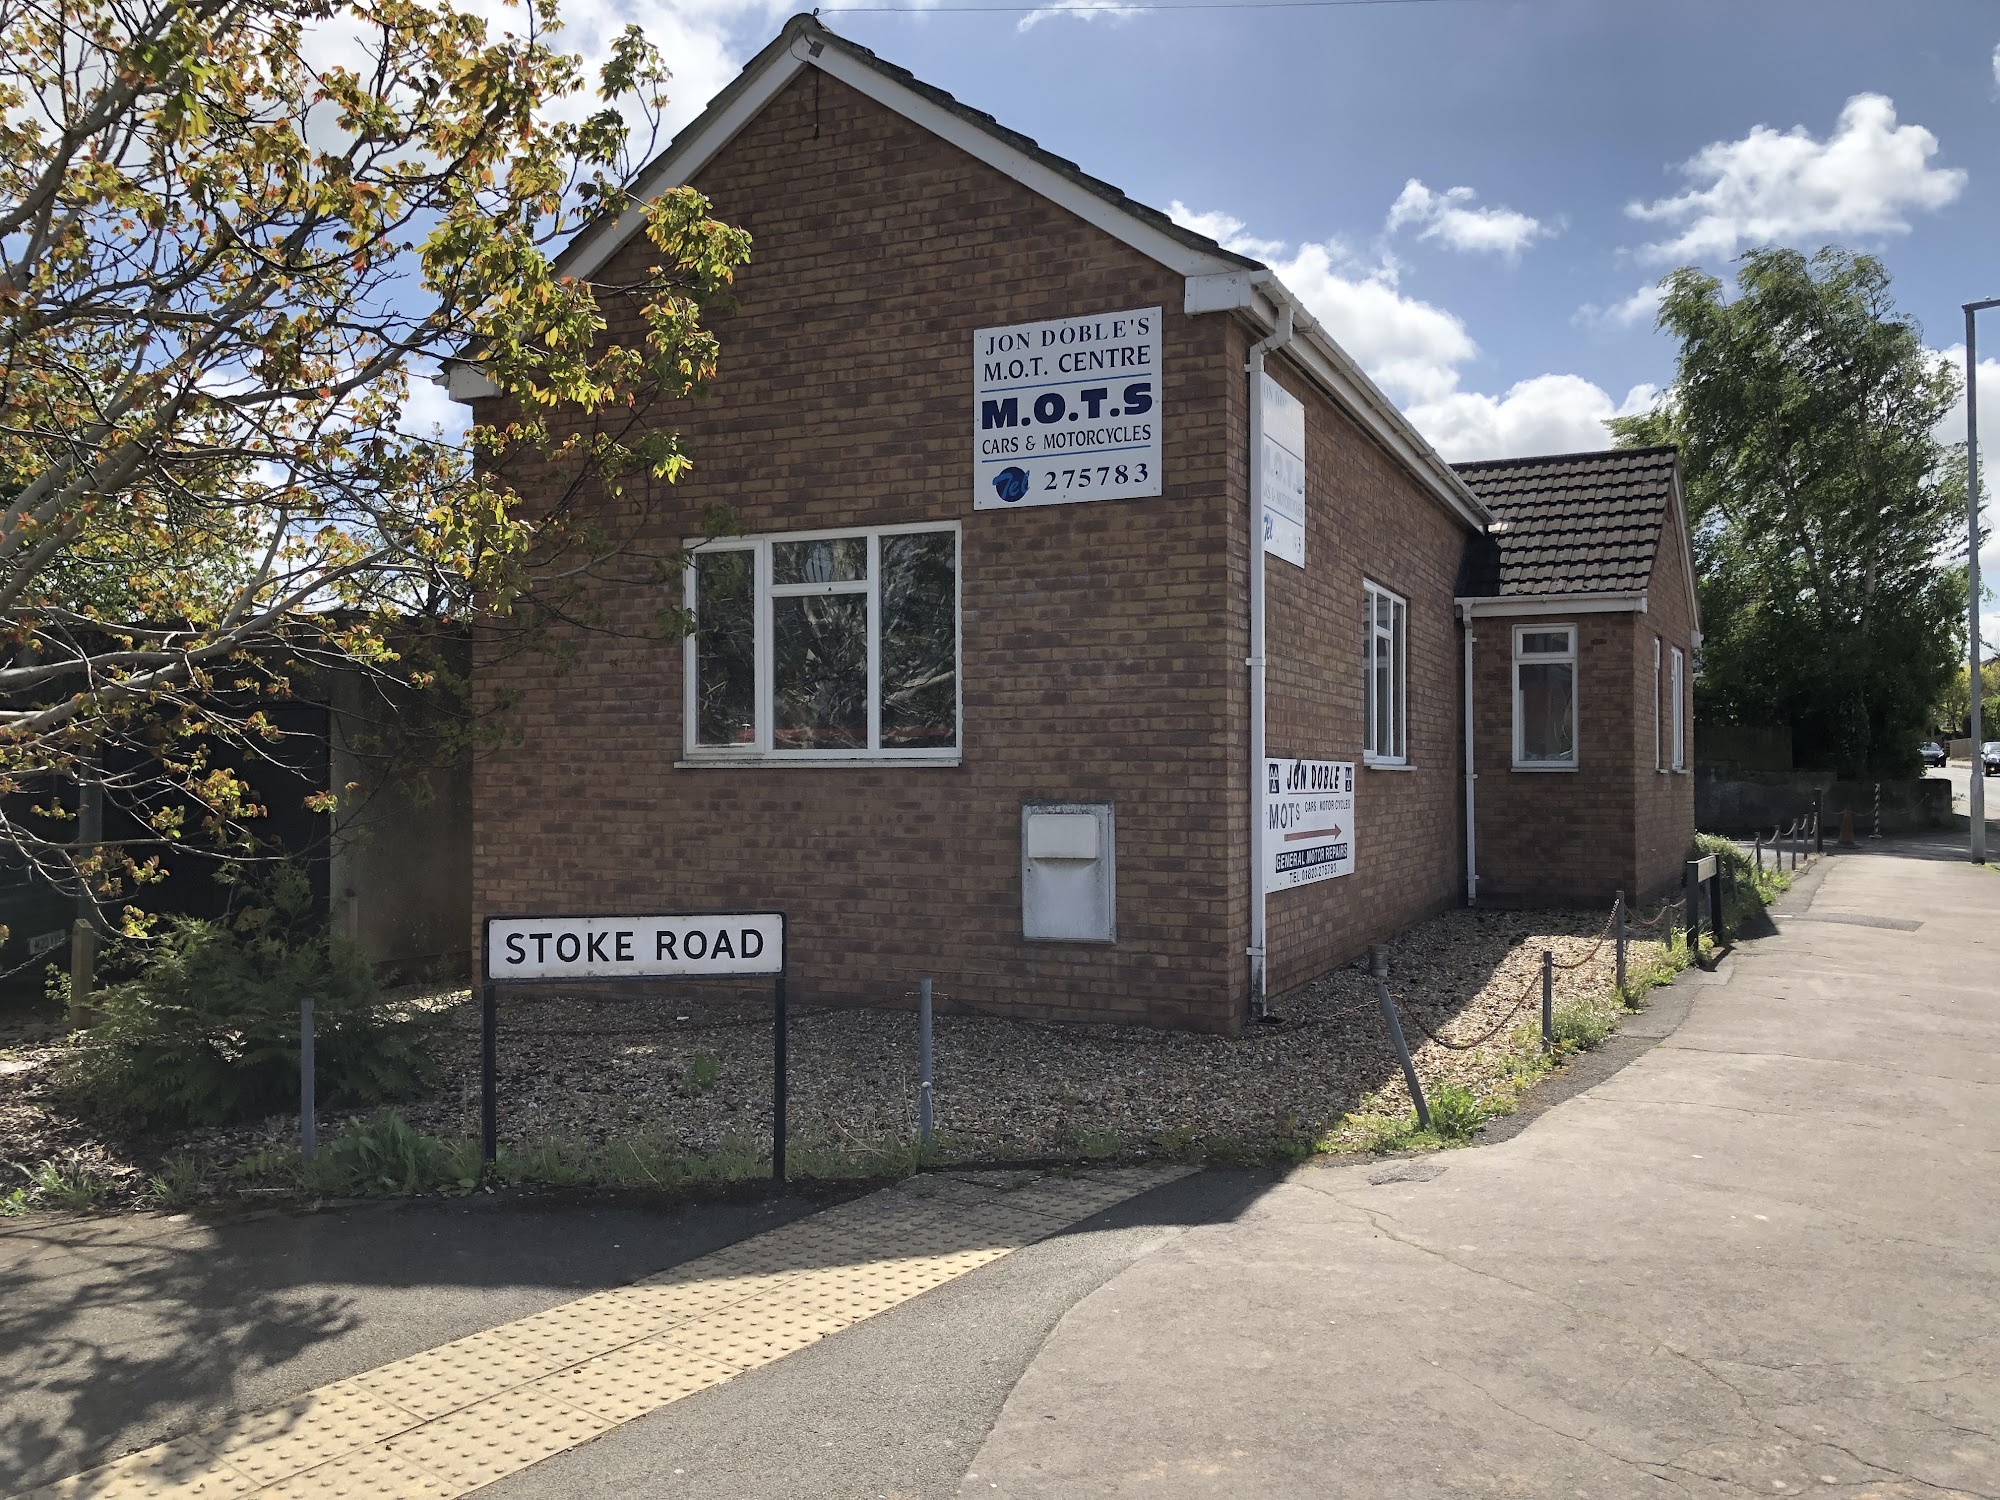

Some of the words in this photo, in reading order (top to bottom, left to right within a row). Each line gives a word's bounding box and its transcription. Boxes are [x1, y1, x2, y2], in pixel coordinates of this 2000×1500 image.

[985, 332, 1030, 356] JON
[1041, 317, 1150, 348] DOBLE'S
[984, 357, 1048, 382] M.O.T.
[1058, 345, 1151, 373] CENTRE
[981, 382, 1153, 430] M.O.T.S
[982, 436, 1019, 455] CARS
[1025, 435, 1036, 451] &
[1043, 424, 1151, 449] MOTORCYCLES
[992, 469, 1030, 500] Tel
[1044, 462, 1149, 491] 275783
[1286, 764, 1307, 790] JON
[1311, 764, 1340, 790] DOBLE
[1269, 802, 1300, 830] MOTS
[1304, 801, 1317, 813] CARS
[1276, 851, 1305, 870] GENERAL
[1306, 848, 1325, 864] MOTOR
[1325, 843, 1348, 861] REPAIRS
[1289, 871, 1300, 884] TEL
[505, 931, 635, 965] STOKE
[656, 928, 764, 961] ROAD
